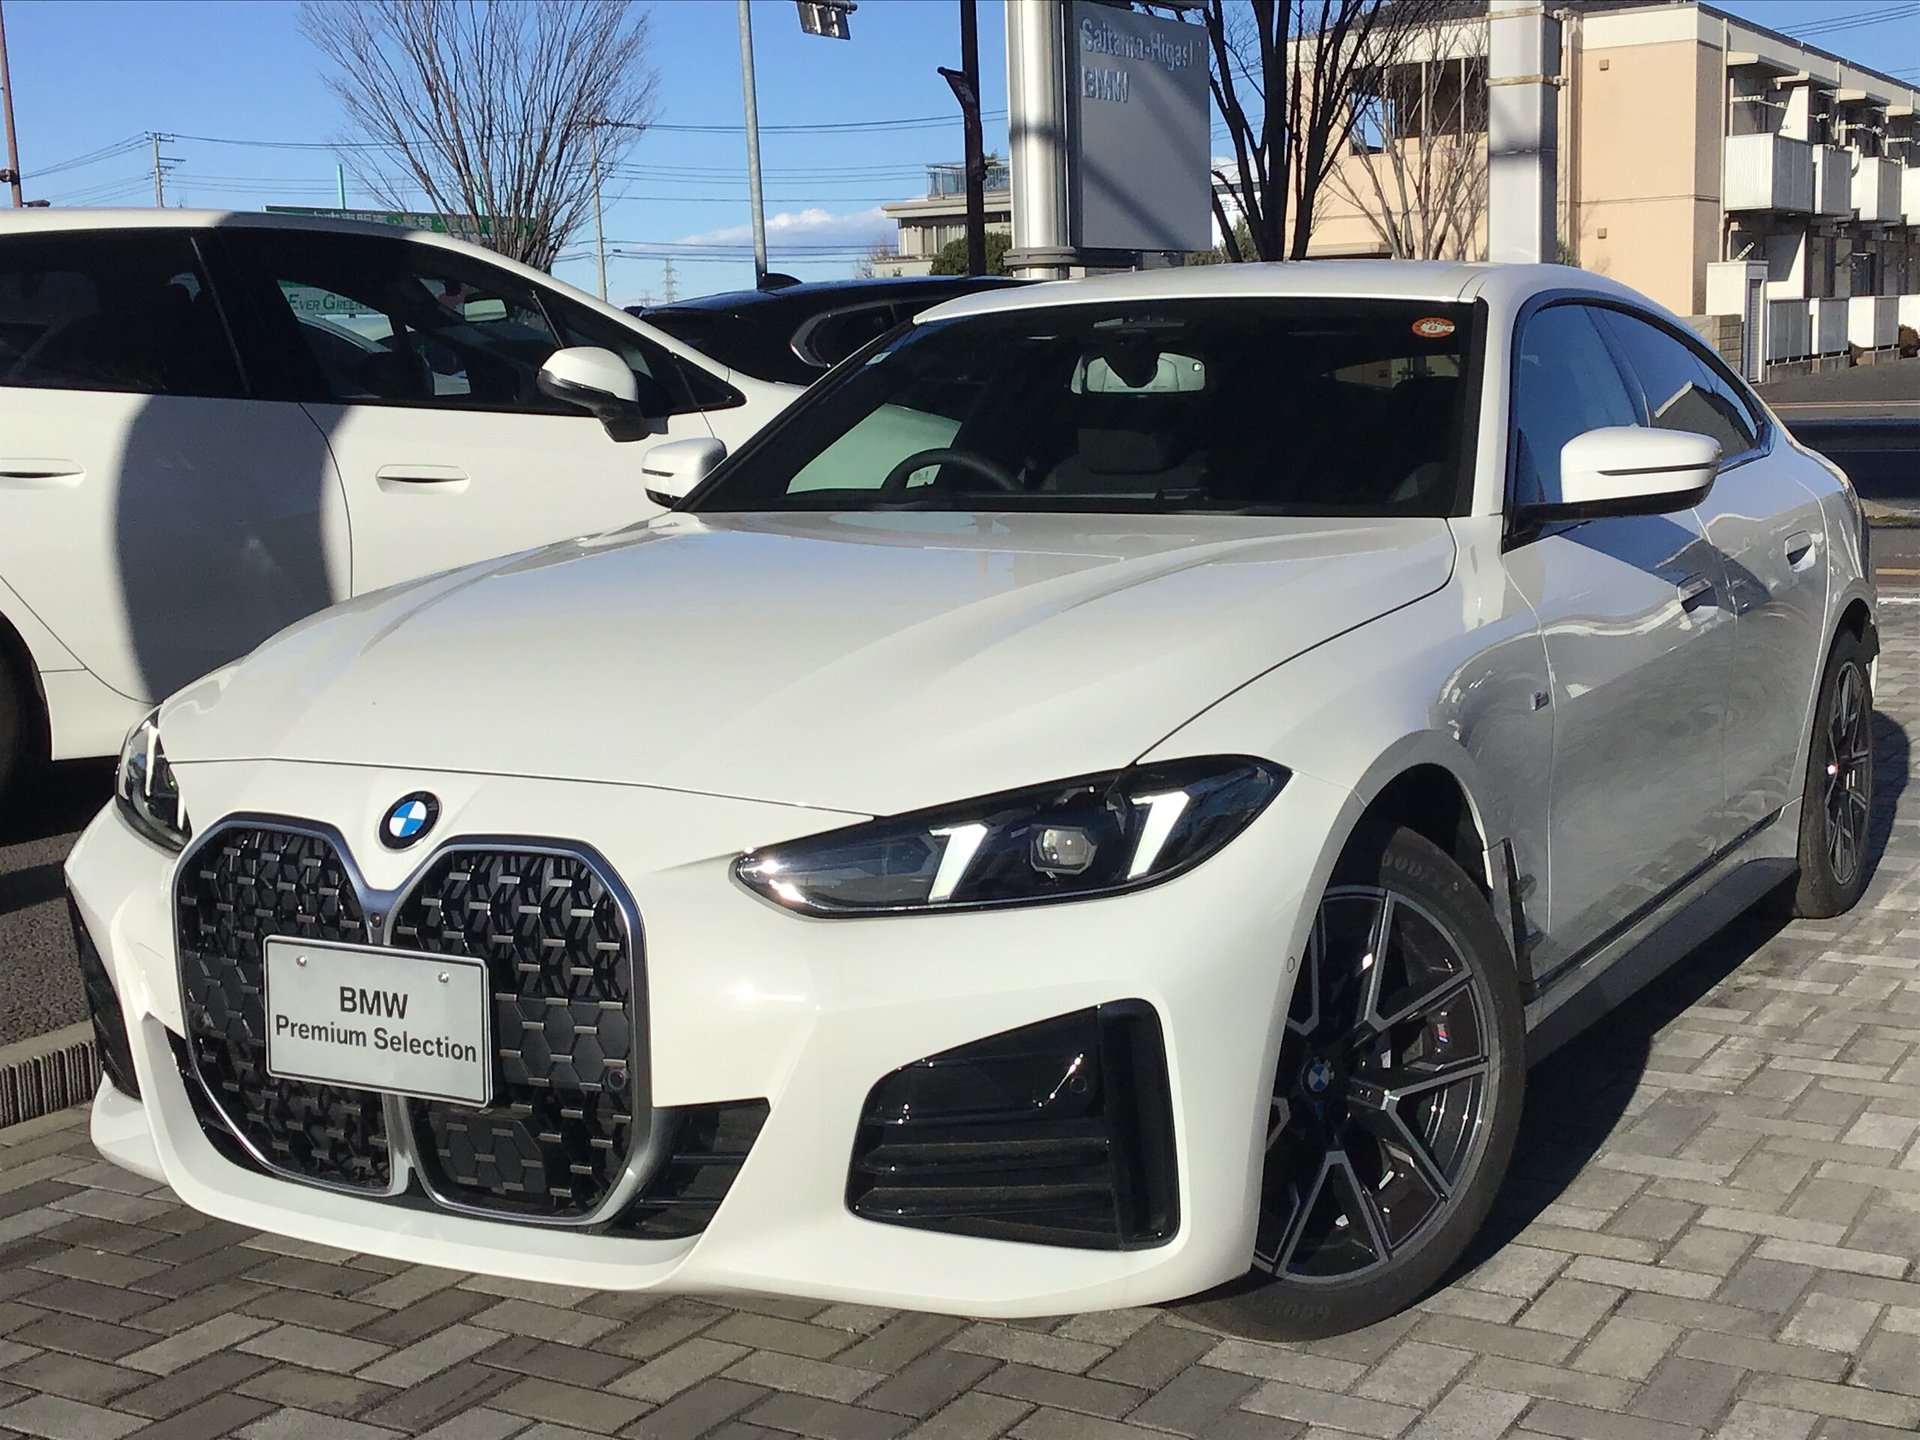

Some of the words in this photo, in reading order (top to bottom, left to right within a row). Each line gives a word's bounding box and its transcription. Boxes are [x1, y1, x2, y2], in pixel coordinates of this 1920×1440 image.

[1082, 65, 1129, 103] BMW
[339, 986, 409, 1019] BMW
[275, 1014, 367, 1047] Premium
[373, 1027, 477, 1063] Selection
